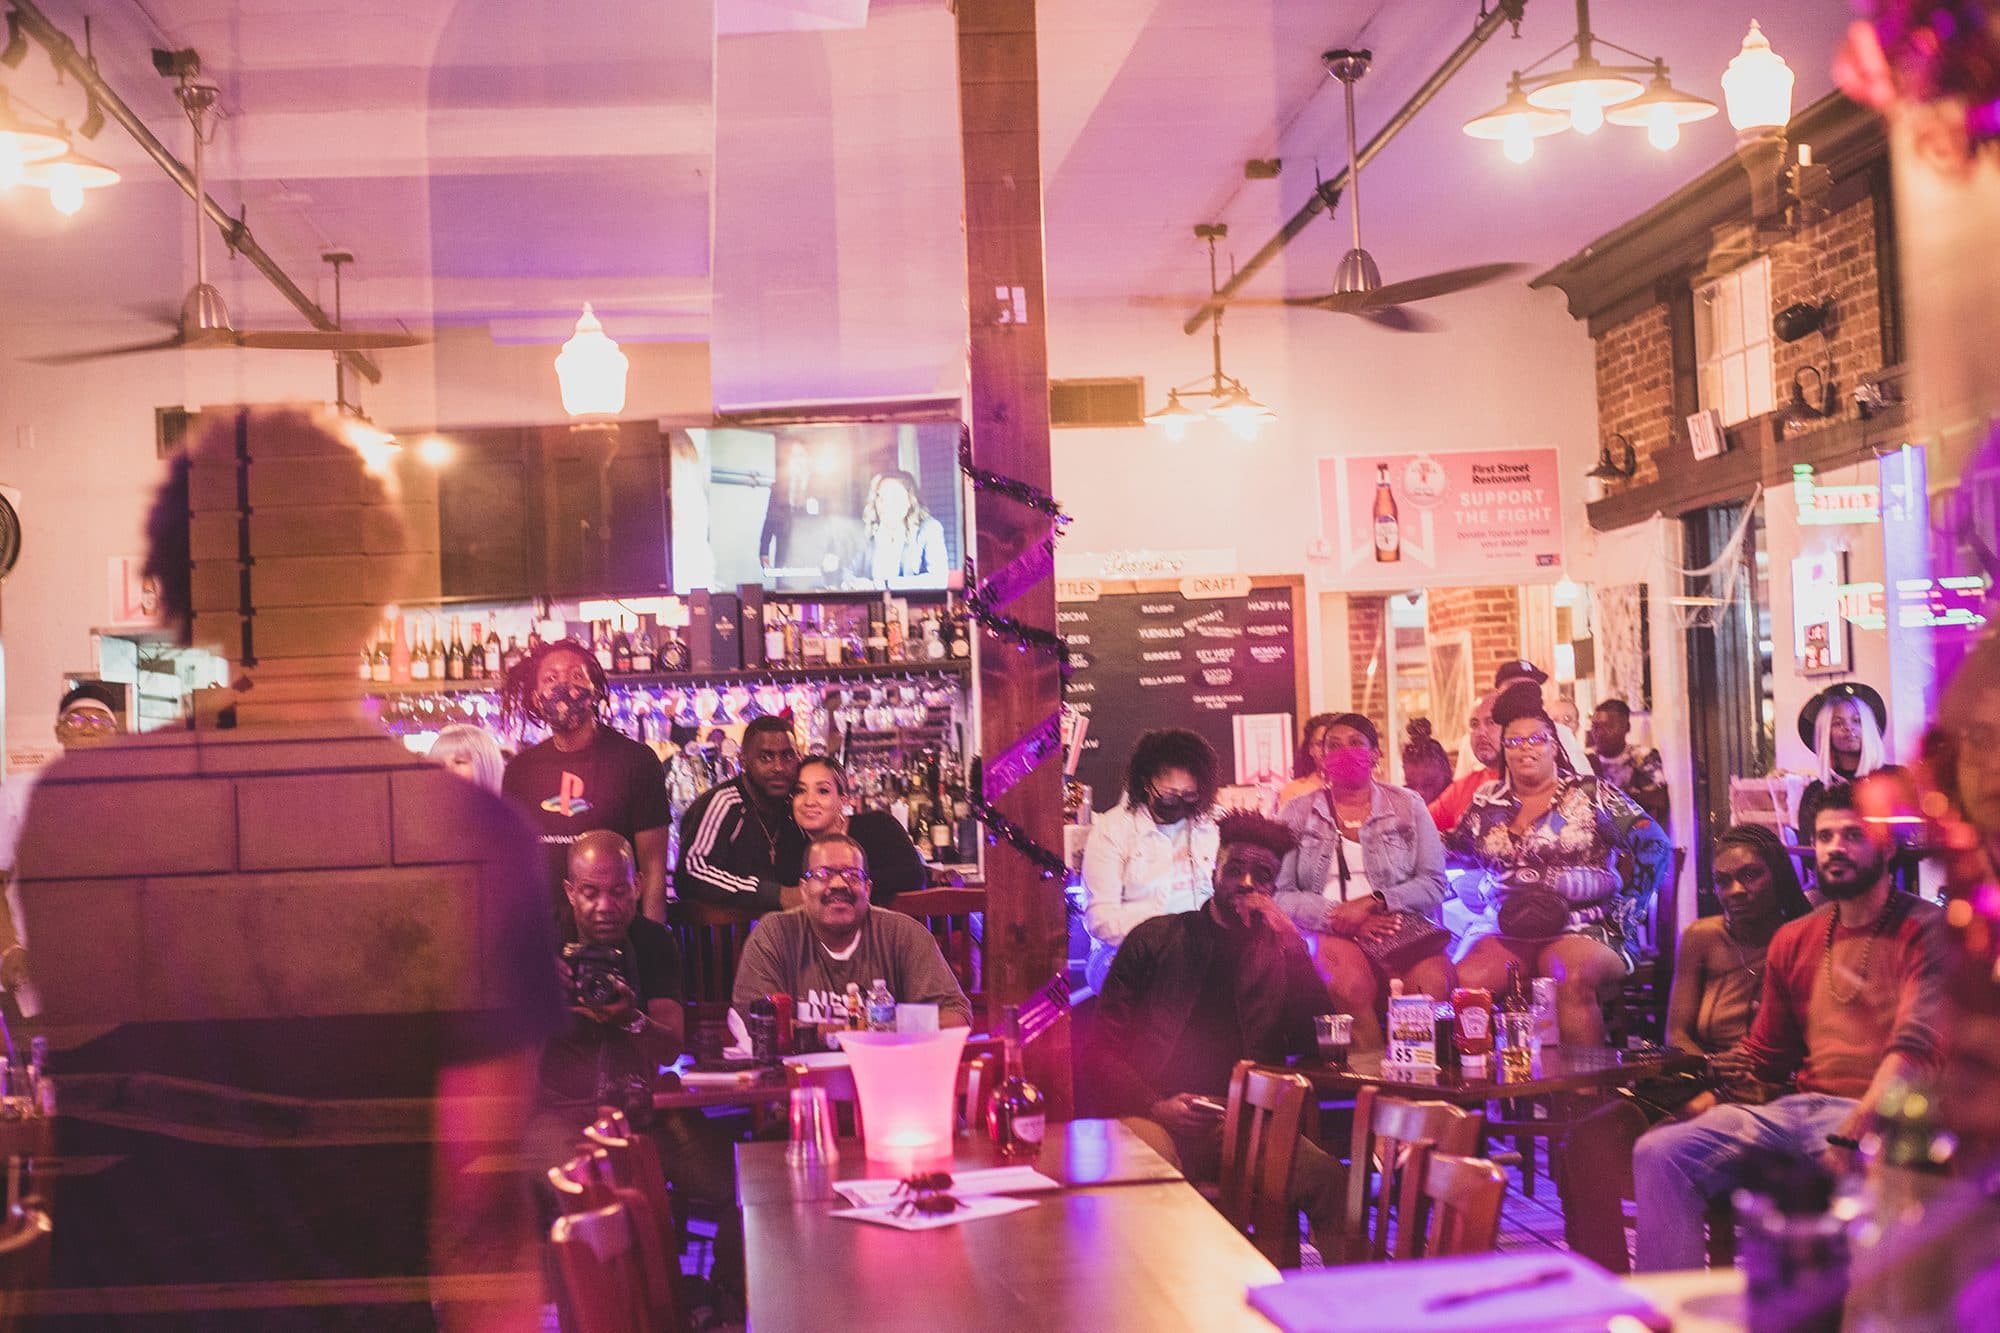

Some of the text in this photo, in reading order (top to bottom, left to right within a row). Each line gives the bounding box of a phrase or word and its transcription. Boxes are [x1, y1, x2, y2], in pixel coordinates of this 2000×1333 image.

[1472, 464, 1531, 474] First Street
[1472, 475, 1531, 485] Restaurant
[1460, 490, 1544, 506] SUPPORT
[1455, 507, 1552, 525] THE FIGHT
[1057, 582, 1096, 595] TTLES
[1193, 577, 1237, 593] DRAFT
[1395, 1047, 1413, 1063] $5
